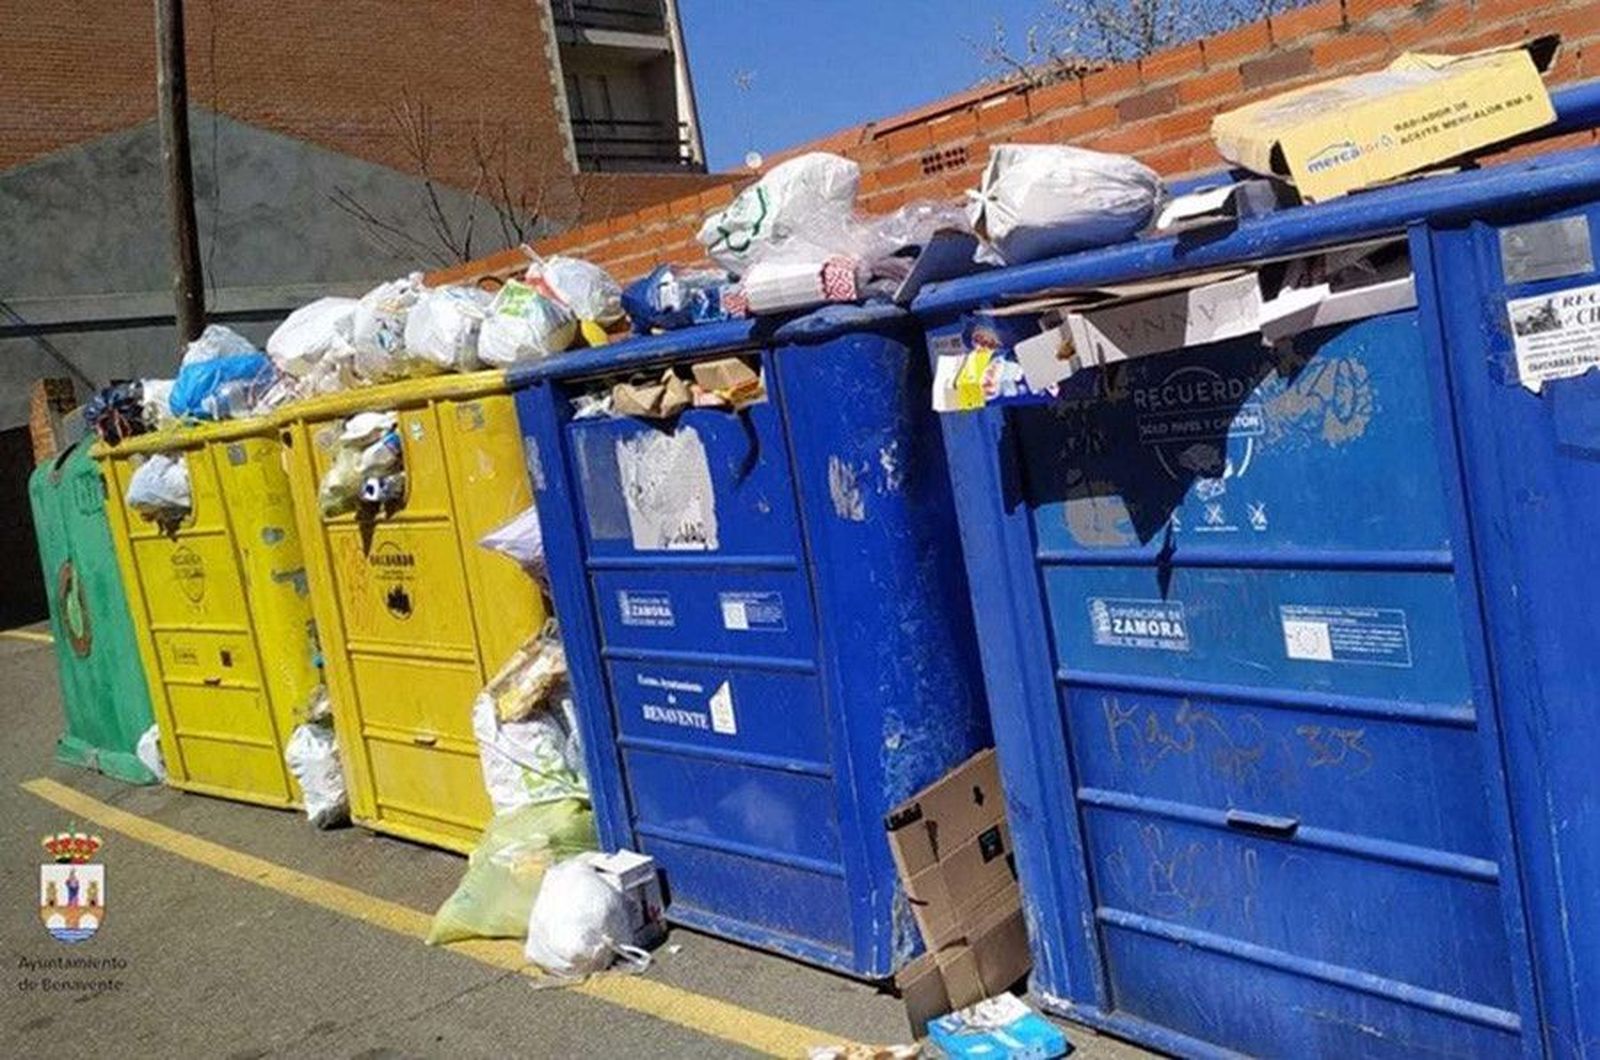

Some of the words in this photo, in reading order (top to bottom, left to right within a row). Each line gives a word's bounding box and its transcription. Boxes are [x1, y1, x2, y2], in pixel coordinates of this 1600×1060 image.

[1133, 377, 1260, 409] RECUERD
[1112, 618, 1185, 638] ZAMORA
[642, 704, 708, 730] BENAVENTE
